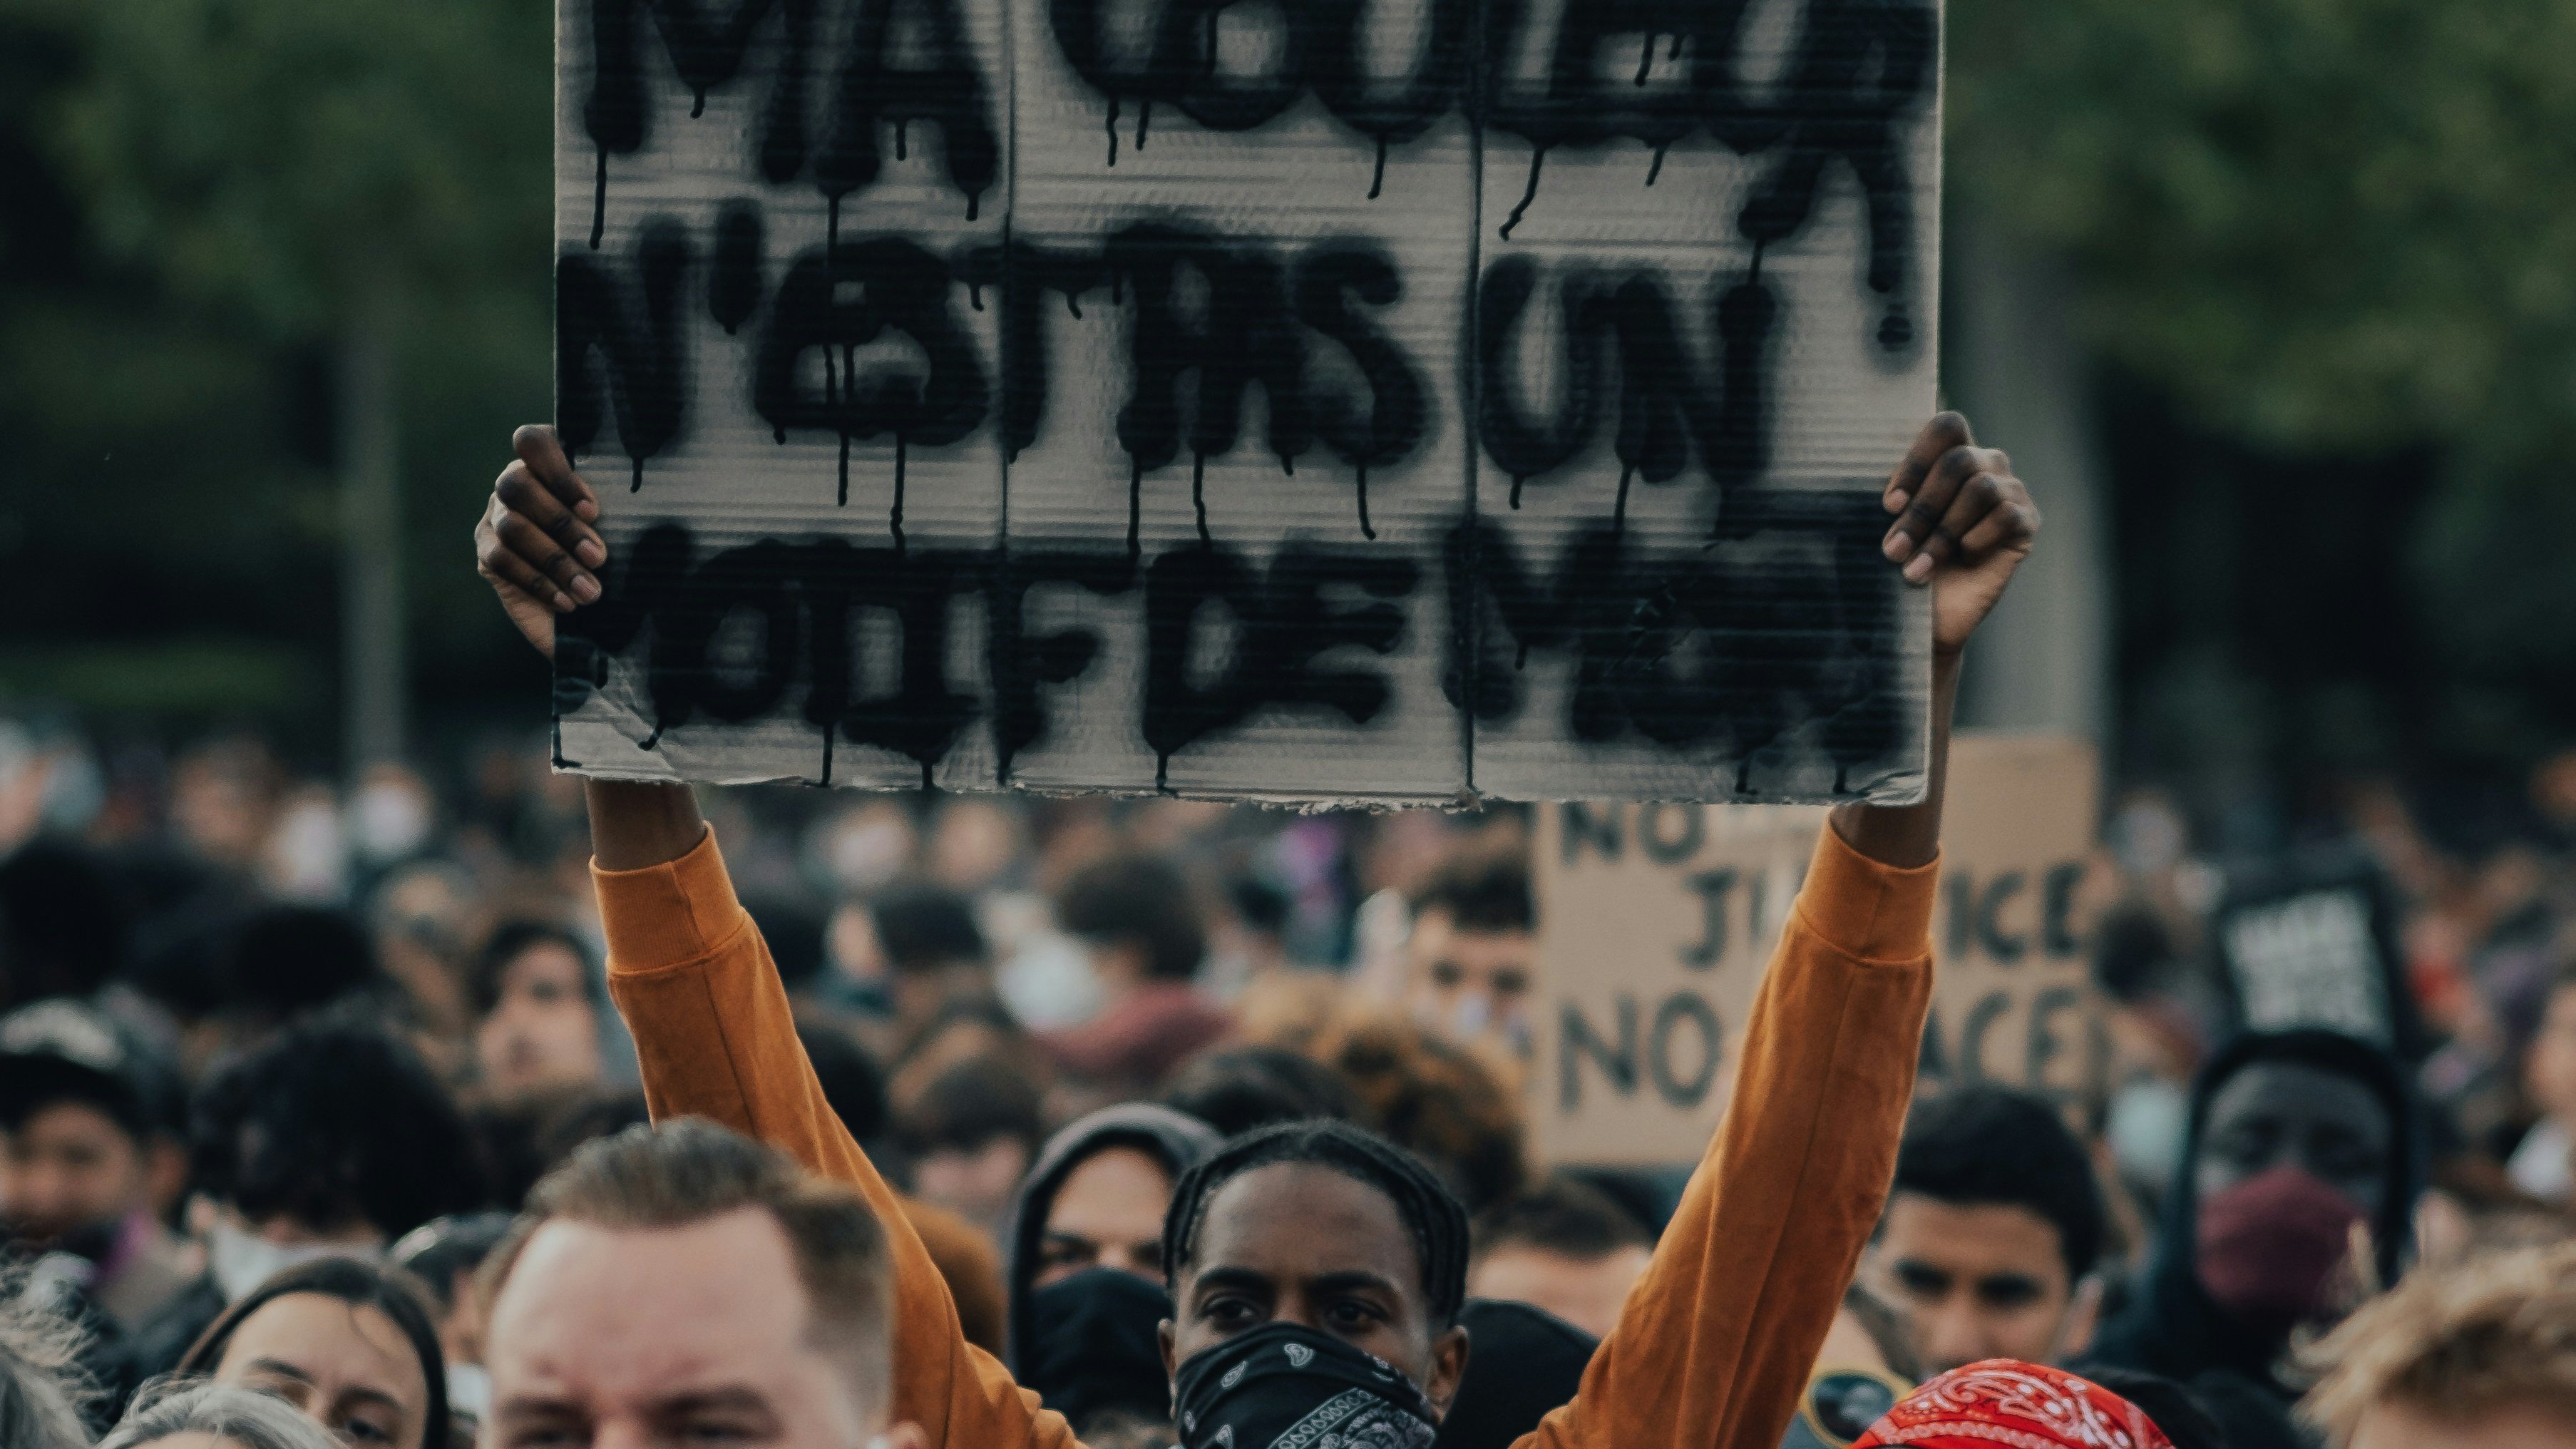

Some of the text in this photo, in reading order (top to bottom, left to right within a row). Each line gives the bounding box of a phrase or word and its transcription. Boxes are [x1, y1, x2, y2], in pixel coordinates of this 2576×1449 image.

[581, 0, 1000, 198] MA
[1477, 253, 1779, 492] UN
[1141, 546, 1419, 752] DE
[1676, 863, 2083, 970] JICE
[1554, 991, 1722, 1114] NO
